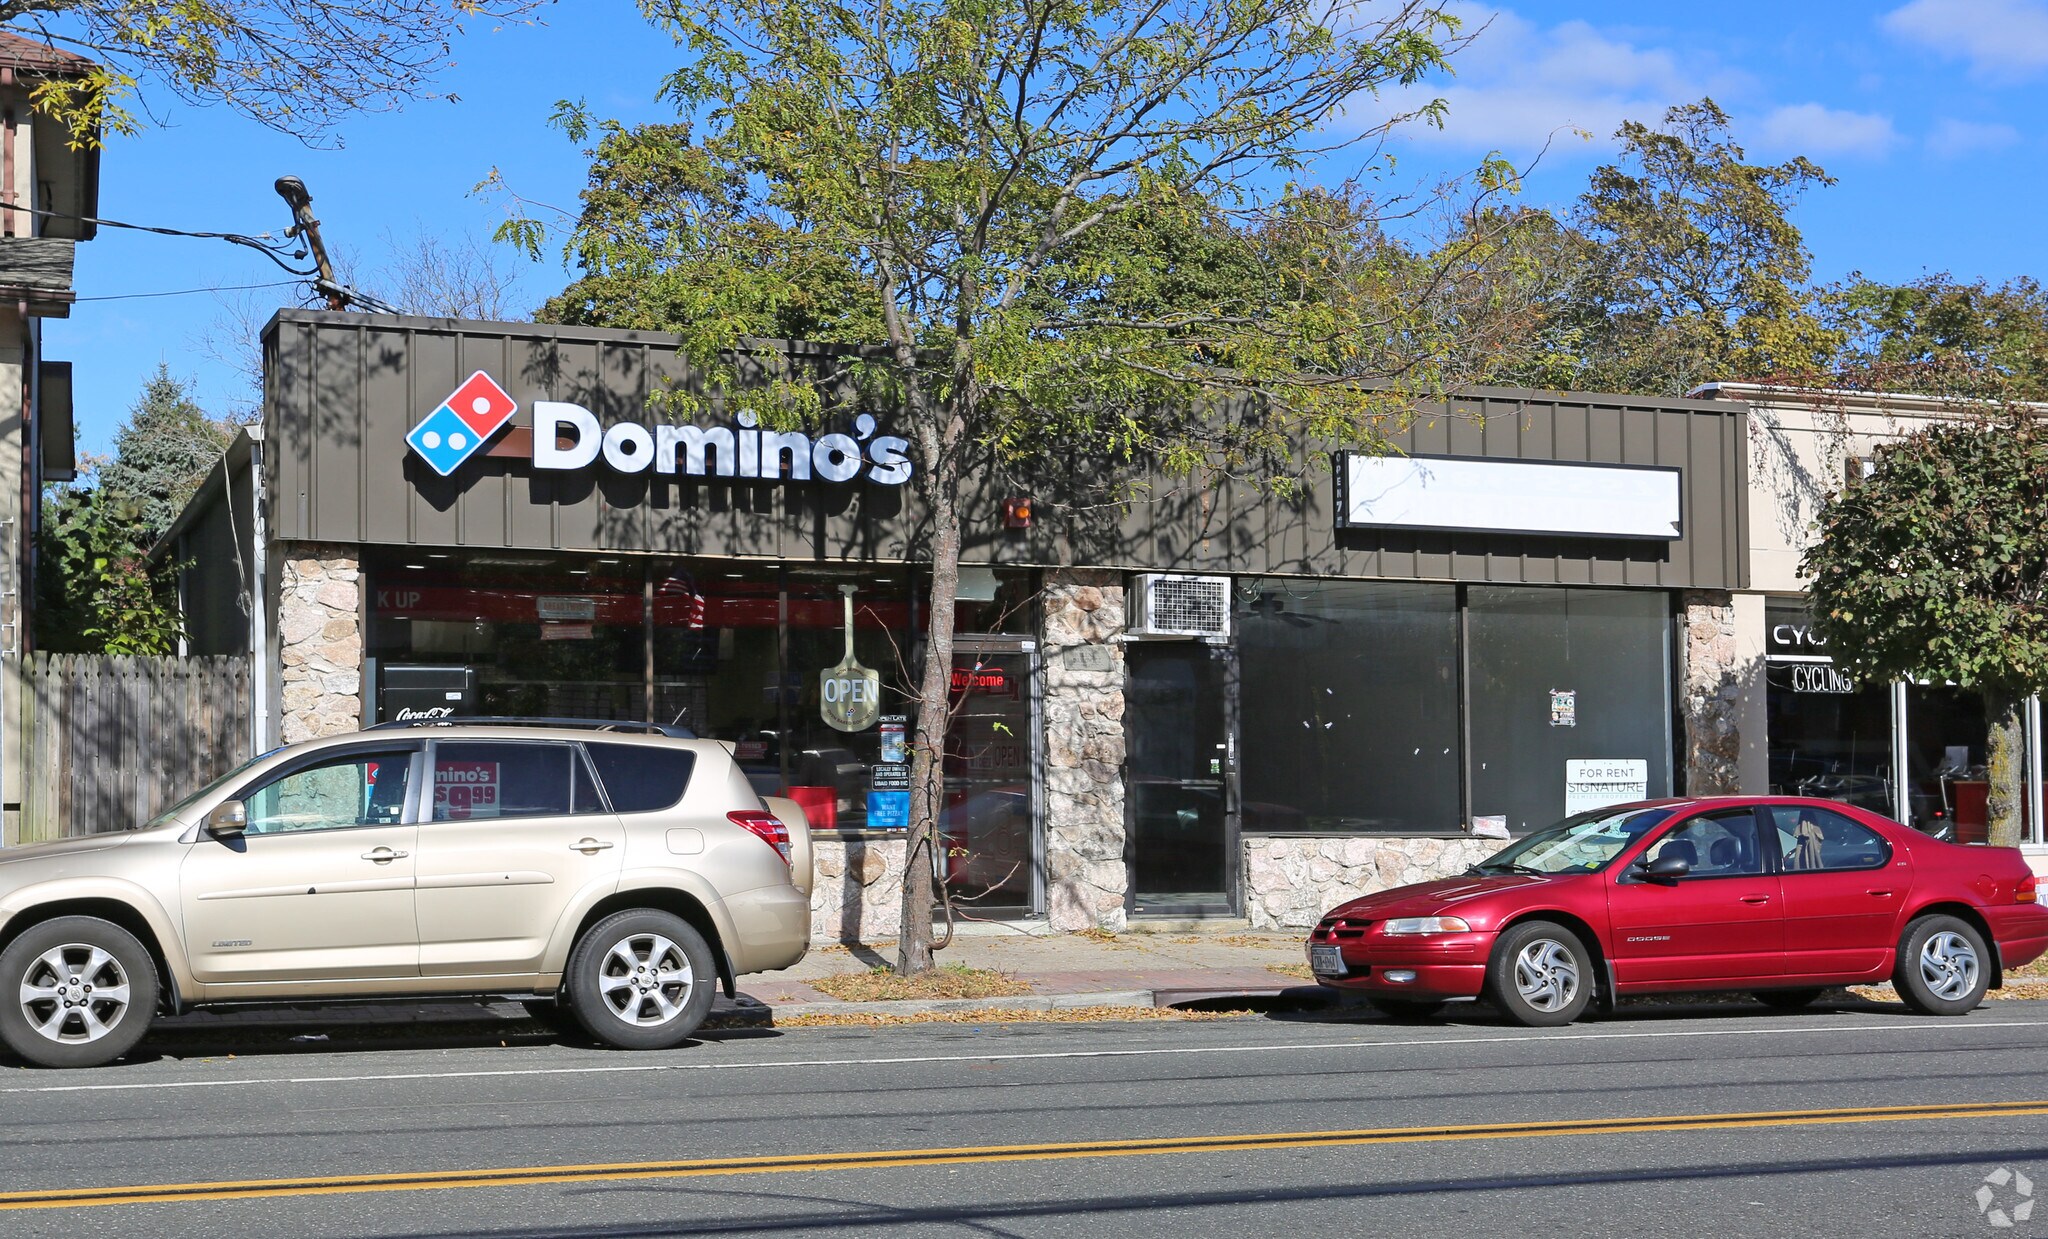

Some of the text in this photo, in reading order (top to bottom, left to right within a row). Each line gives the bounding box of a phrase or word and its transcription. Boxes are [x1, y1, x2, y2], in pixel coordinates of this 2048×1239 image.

[533, 401, 914, 486] Domino's
[1335, 453, 1343, 498] OPEN
[395, 591, 421, 609] UP
[951, 672, 1004, 687] Welcome
[1794, 665, 1853, 692] CYCLING
[824, 678, 877, 703] OPEN
[994, 745, 1020, 768] OPEN
[1579, 768, 1635, 778] FOR RENT
[1568, 782, 1645, 793] SIGNATURE
[211, 940, 253, 948] LIMITED
[1626, 935, 1671, 943] DODGE
